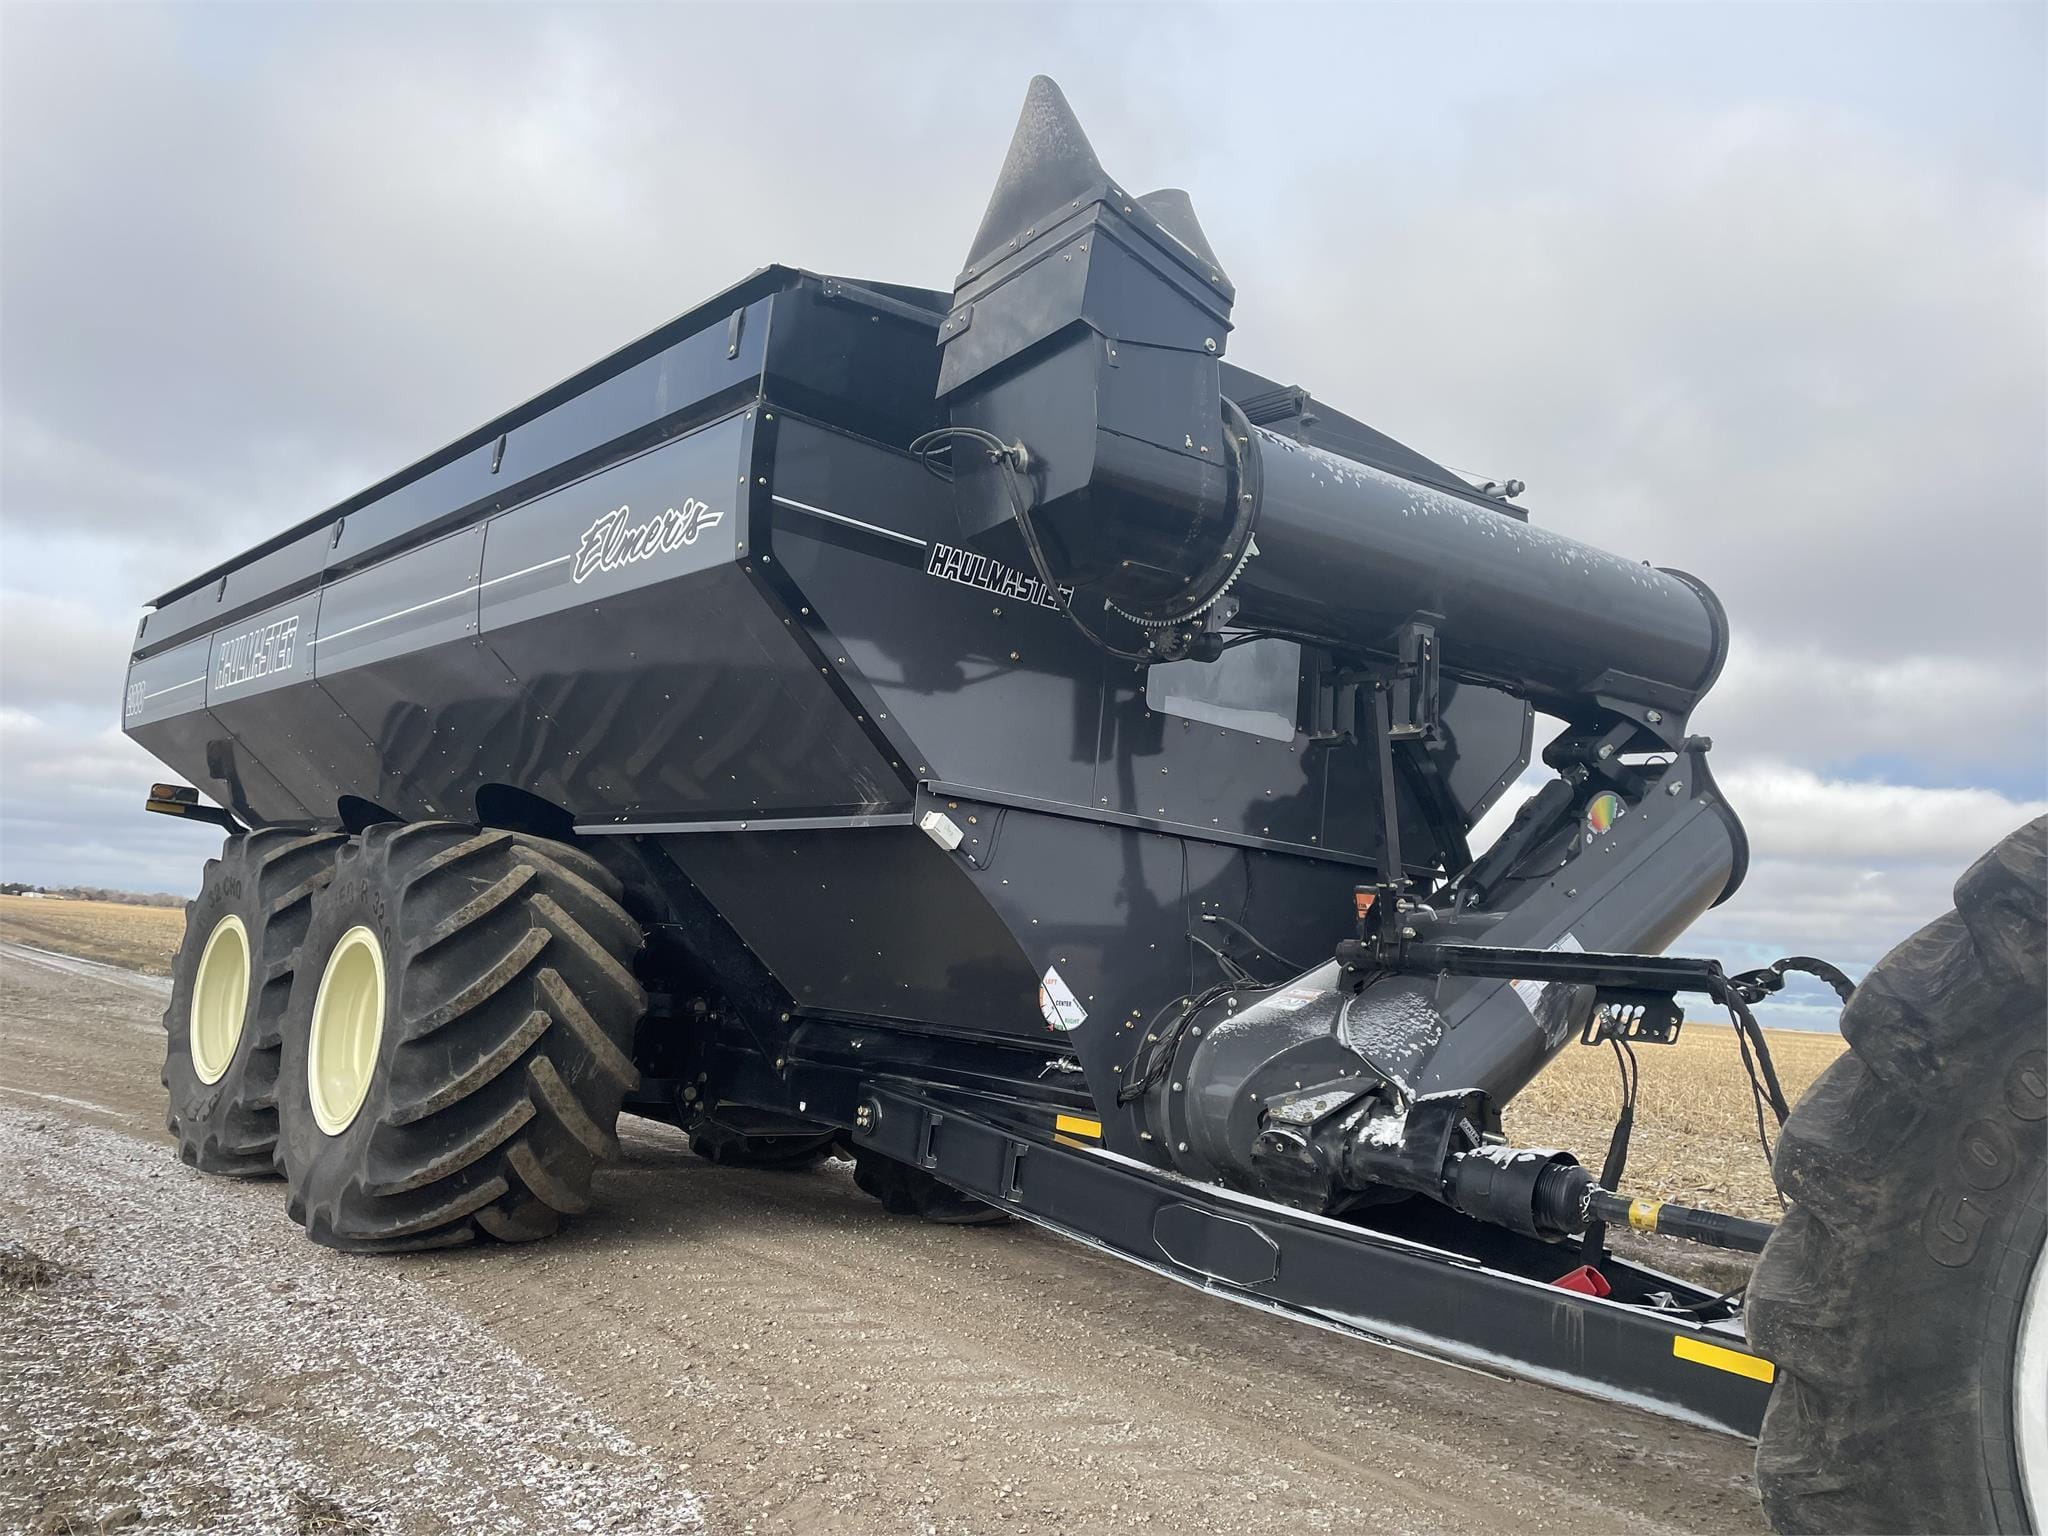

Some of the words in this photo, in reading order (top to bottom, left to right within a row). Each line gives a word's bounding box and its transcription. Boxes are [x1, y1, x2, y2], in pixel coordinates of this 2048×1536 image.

[572, 497, 725, 584] Elmer's
[927, 542, 1075, 611] HAULMASTER
[215, 615, 299, 690] HAULMASTER
